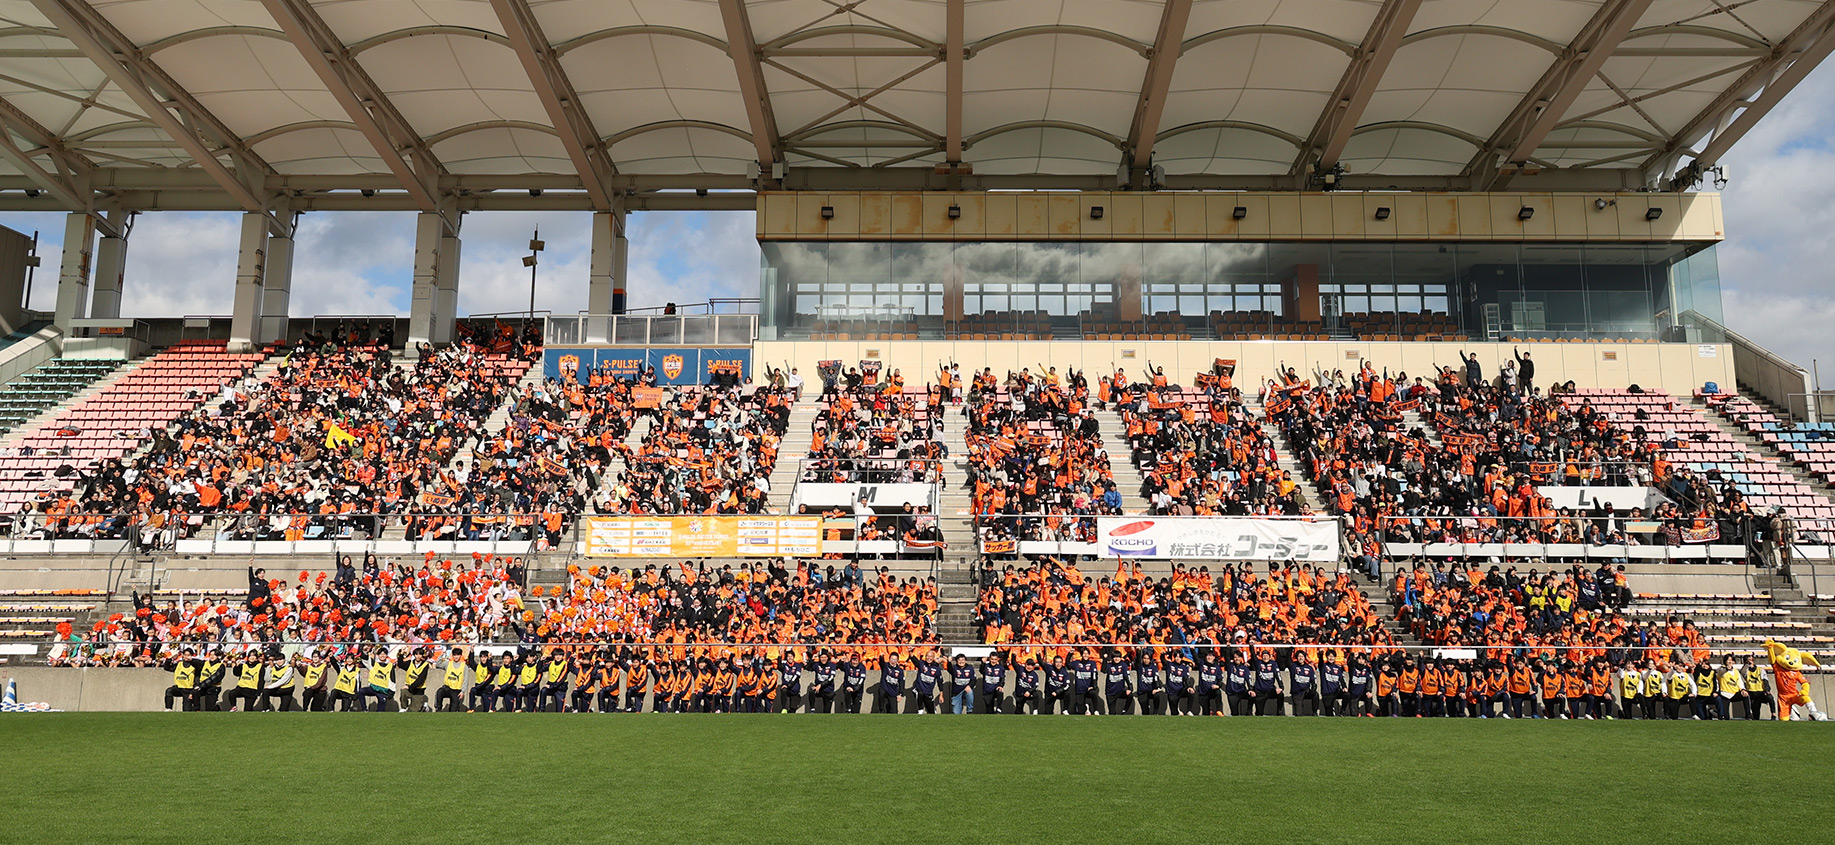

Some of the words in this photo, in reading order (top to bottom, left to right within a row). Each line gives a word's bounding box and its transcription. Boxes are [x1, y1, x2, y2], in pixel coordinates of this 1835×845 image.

[603, 359, 639, 369] S-PULSE
[707, 359, 743, 369] S-PULSE
[857, 486, 878, 503] M
[1578, 489, 1591, 506] L
[1111, 538, 1154, 546] KOCHO
